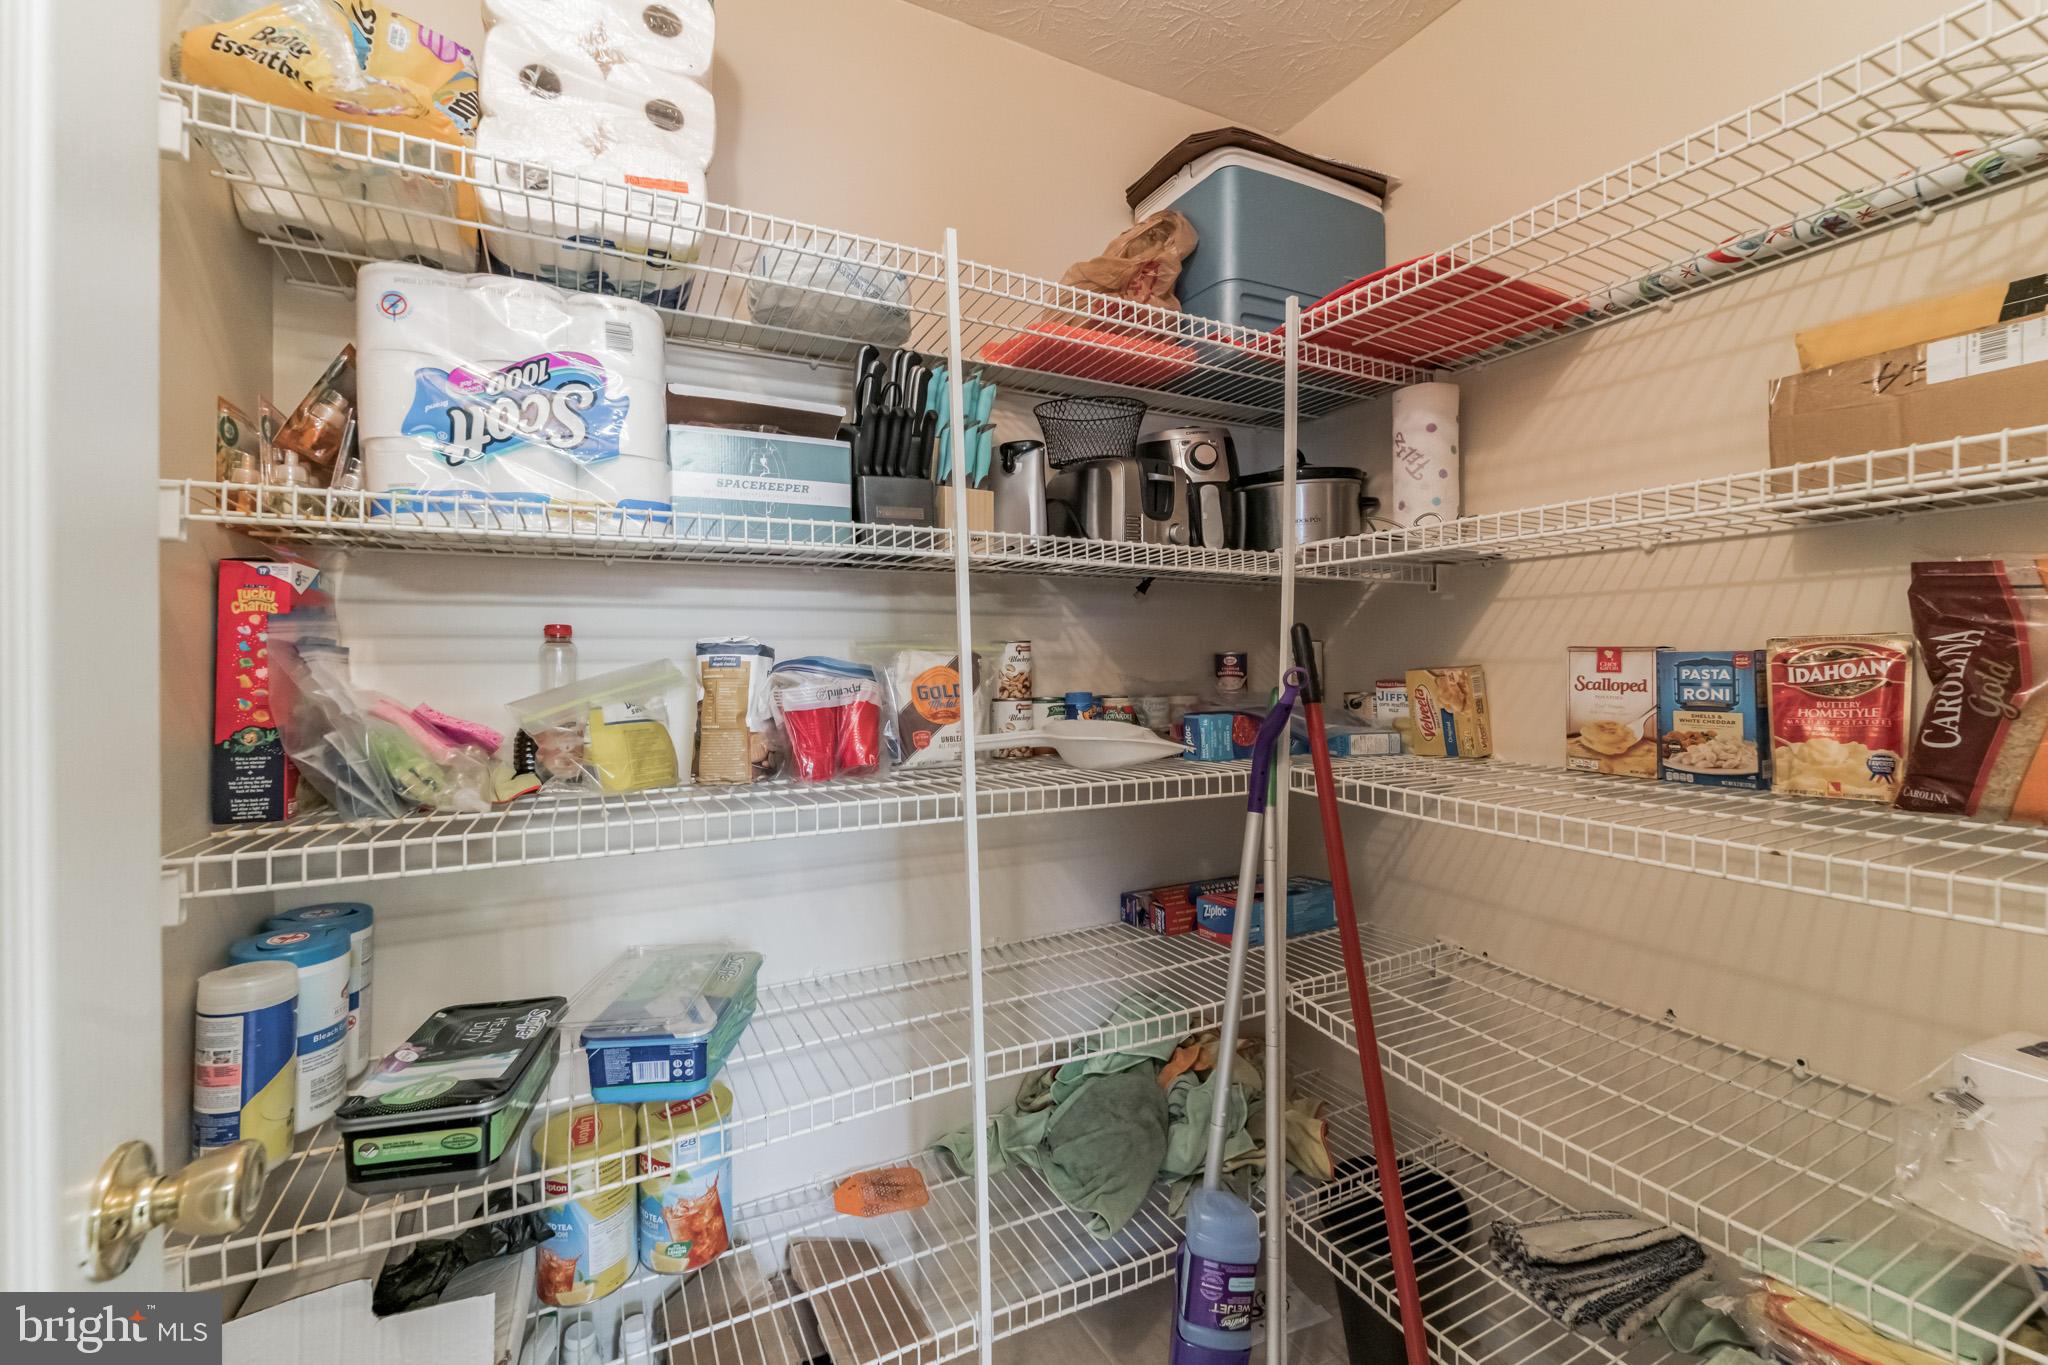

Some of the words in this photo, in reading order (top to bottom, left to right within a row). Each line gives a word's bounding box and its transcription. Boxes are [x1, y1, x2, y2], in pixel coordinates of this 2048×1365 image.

[424, 400, 449, 413] Brand
[449, 383, 597, 462] Scott
[716, 478, 810, 494] SPACEKEEPER
[236, 589, 276, 602] Lucky
[230, 601, 279, 614] Charms
[1681, 669, 1731, 680] PASTA
[1787, 660, 1889, 684] IDAHOAN
[1574, 675, 1648, 695] Scalloped
[1921, 629, 1986, 749] CAROLINA
[1377, 690, 1408, 702] JIFFY
[1683, 688, 1730, 701] RONI
[1414, 688, 1436, 737] Velveeta
[1797, 707, 1881, 718] HOMESTYLE
[1903, 786, 1949, 805] CAROLINA
[1203, 904, 1228, 918] Ziploc
[515, 1008, 551, 1039] Swiffer
[313, 1026, 339, 1043] Bleach
[578, 1116, 594, 1144] Lipton
[545, 1183, 567, 1193] ipton
[1220, 1315, 1249, 1328] Swiffer
